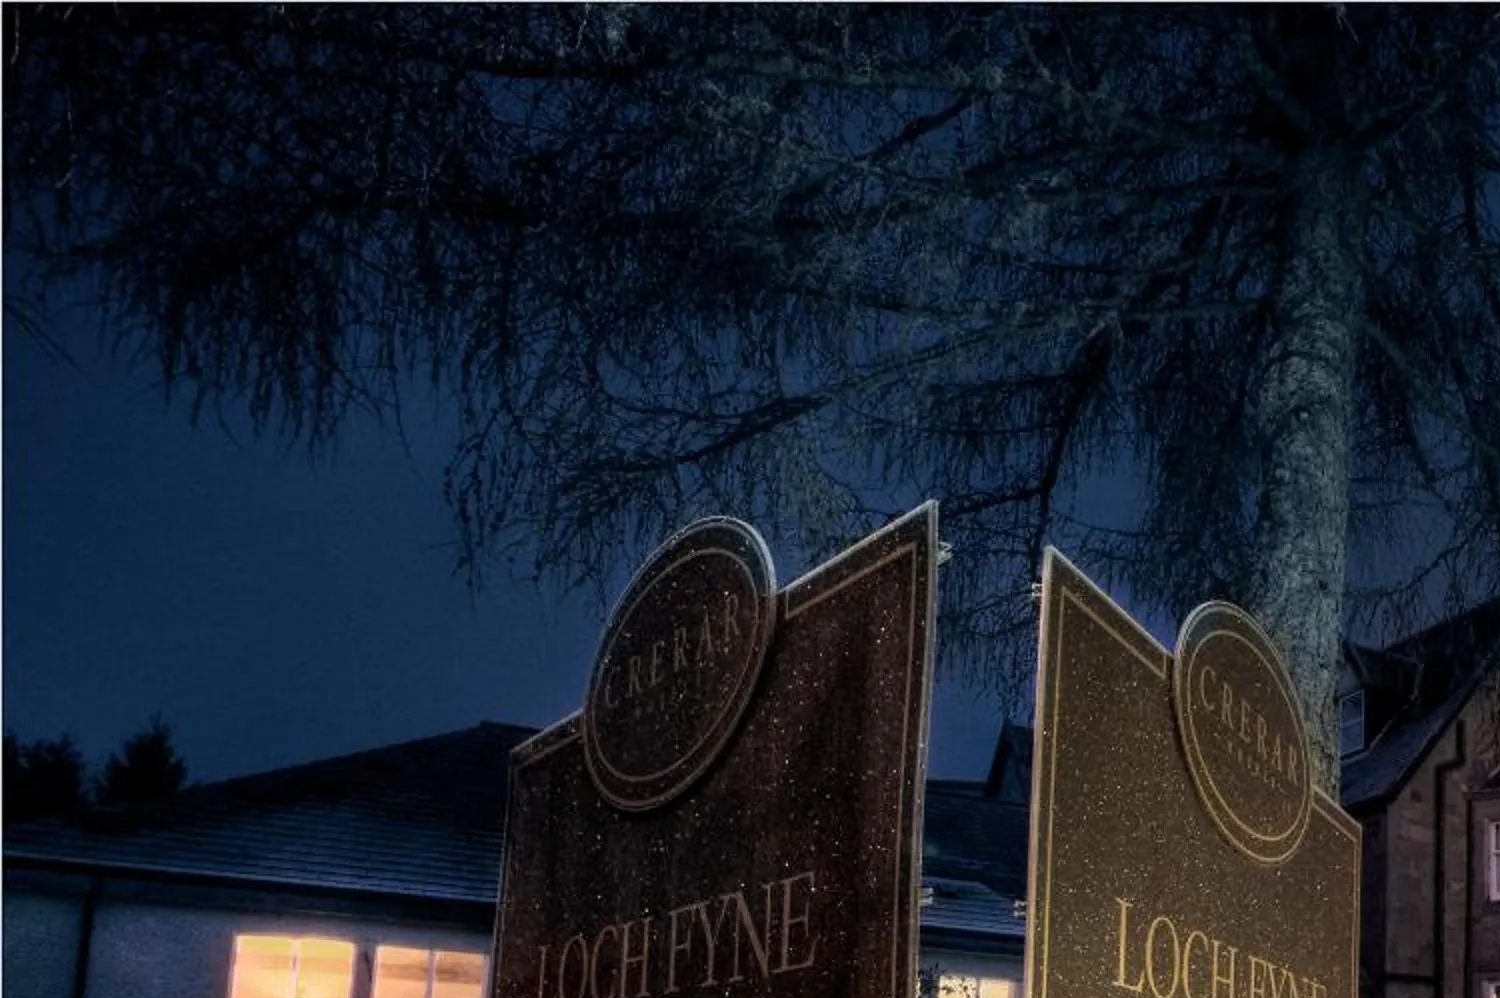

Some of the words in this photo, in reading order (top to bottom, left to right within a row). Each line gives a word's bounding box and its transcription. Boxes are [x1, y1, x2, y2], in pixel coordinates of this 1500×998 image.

[604, 594, 740, 708] CRERAR
[1199, 664, 1299, 786] CRERAR
[664, 871, 820, 996] FYNE
